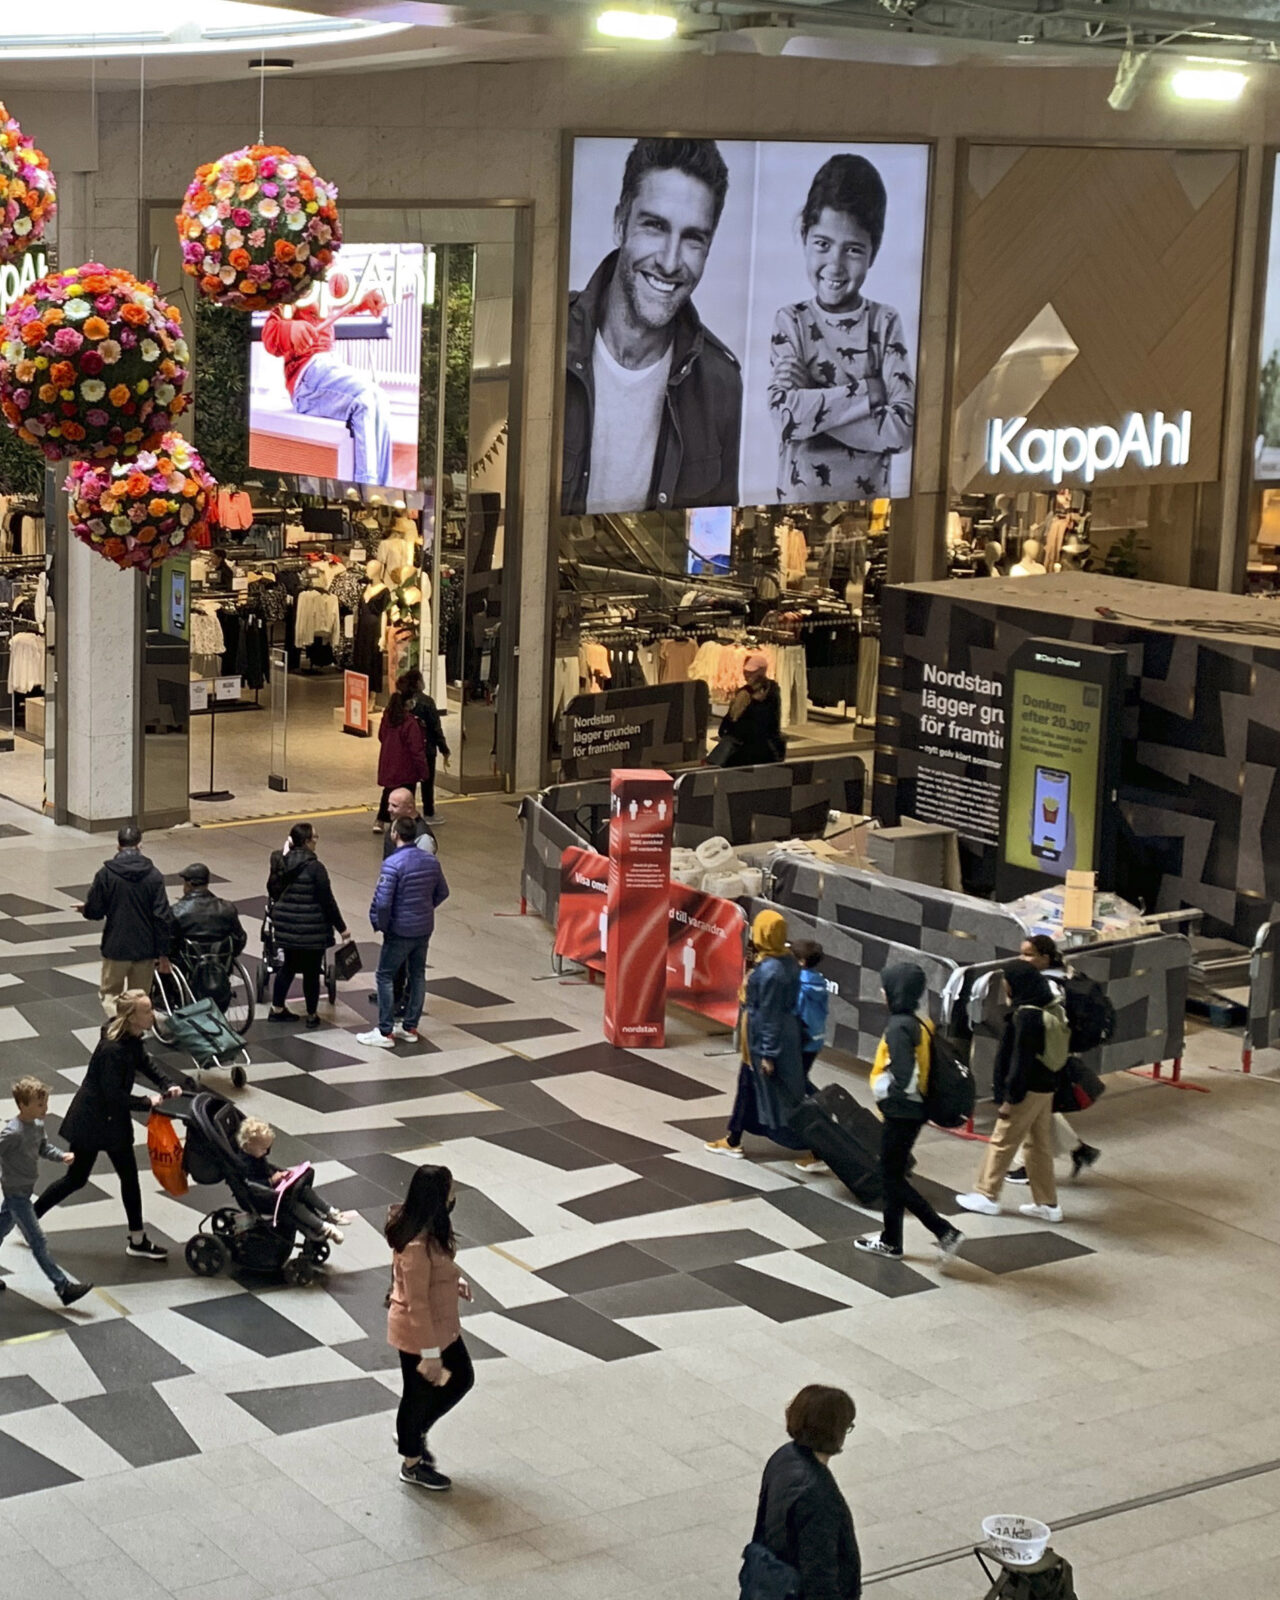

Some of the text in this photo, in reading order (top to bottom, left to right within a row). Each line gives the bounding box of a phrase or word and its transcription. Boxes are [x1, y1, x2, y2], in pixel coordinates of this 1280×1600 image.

[987, 409, 1192, 485] KappAhl
[923, 663, 1003, 697] Nordstan
[922, 688, 977, 717] lägger
[1022, 694, 1066, 714] Donken
[574, 714, 616, 728] Nordstan
[920, 714, 946, 736] för
[1022, 709, 1050, 725] efter
[573, 724, 641, 744] lägger grunden
[573, 741, 630, 757] för framtiden
[575, 872, 591, 887] Visa
[675, 910, 688, 923] till
[688, 918, 728, 939] varandra.
[622, 1025, 658, 1033] nordstan
